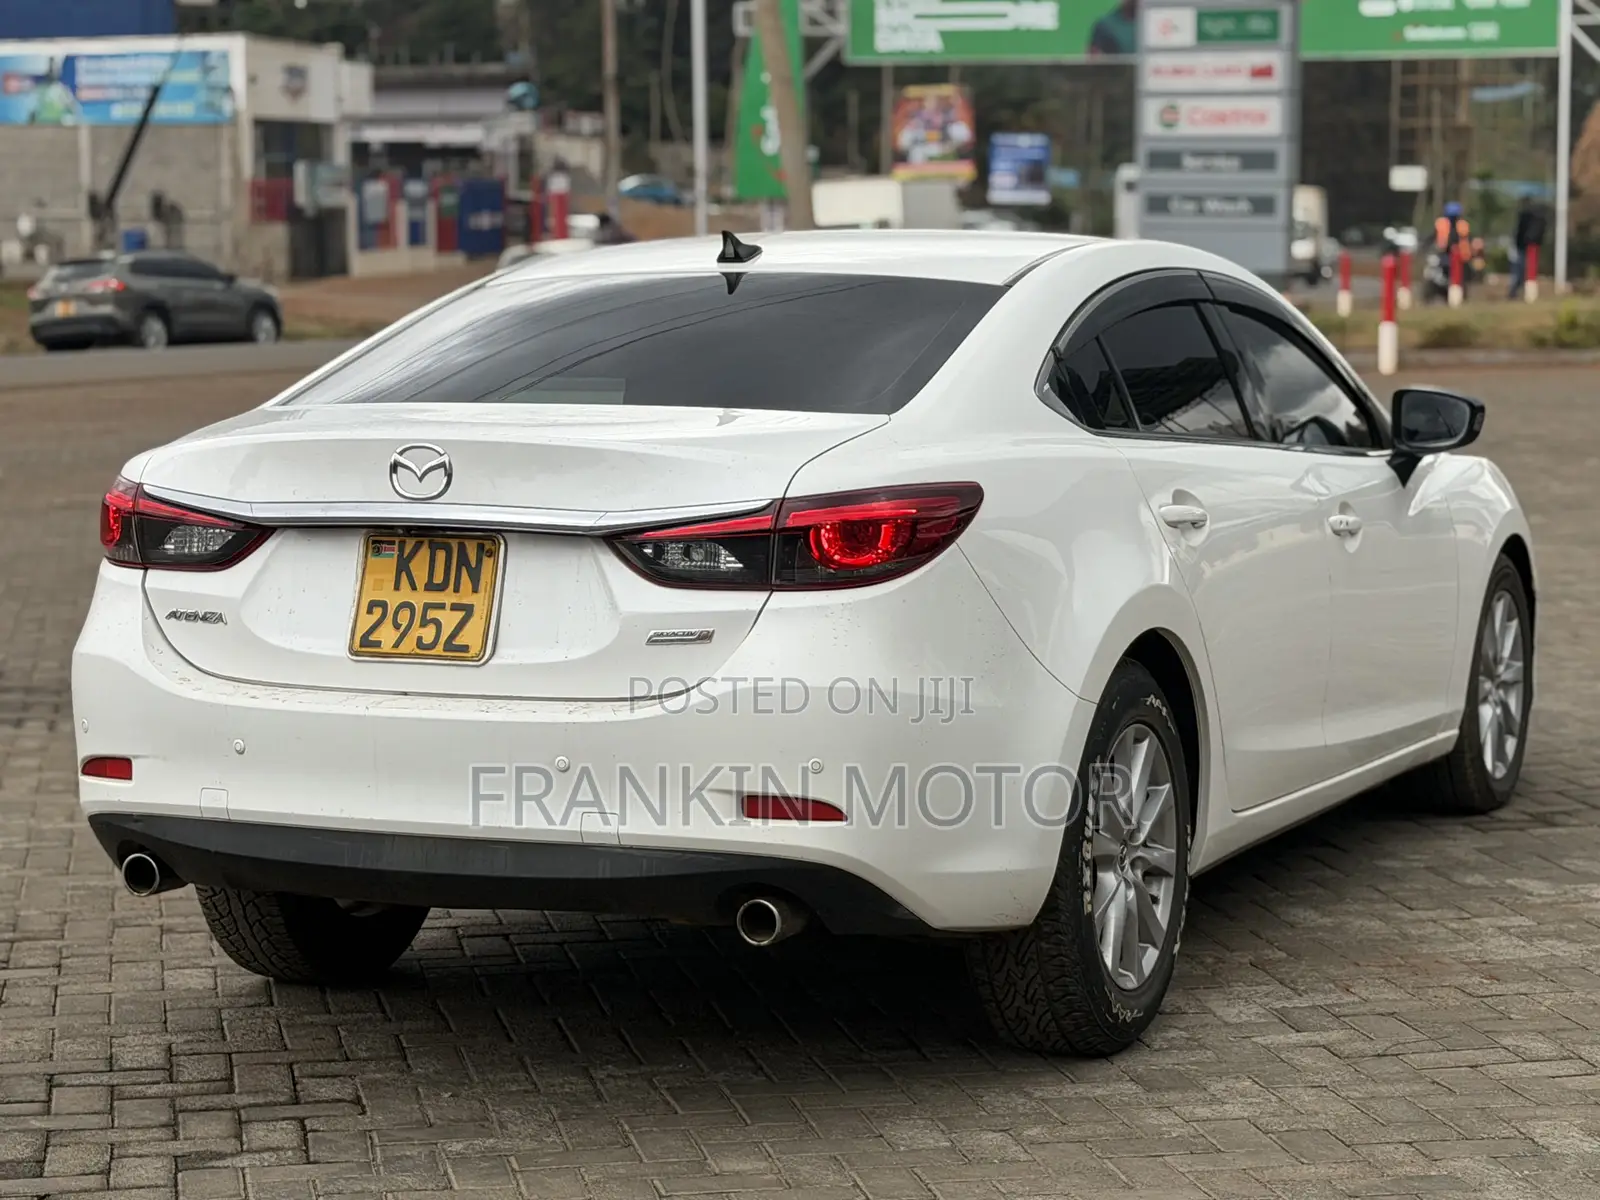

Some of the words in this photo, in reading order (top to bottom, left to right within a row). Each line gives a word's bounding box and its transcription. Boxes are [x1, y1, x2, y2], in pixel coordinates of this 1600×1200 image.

[393, 539, 485, 593] KDN
[165, 608, 227, 625] ATENZA
[358, 600, 476, 654] 295Z
